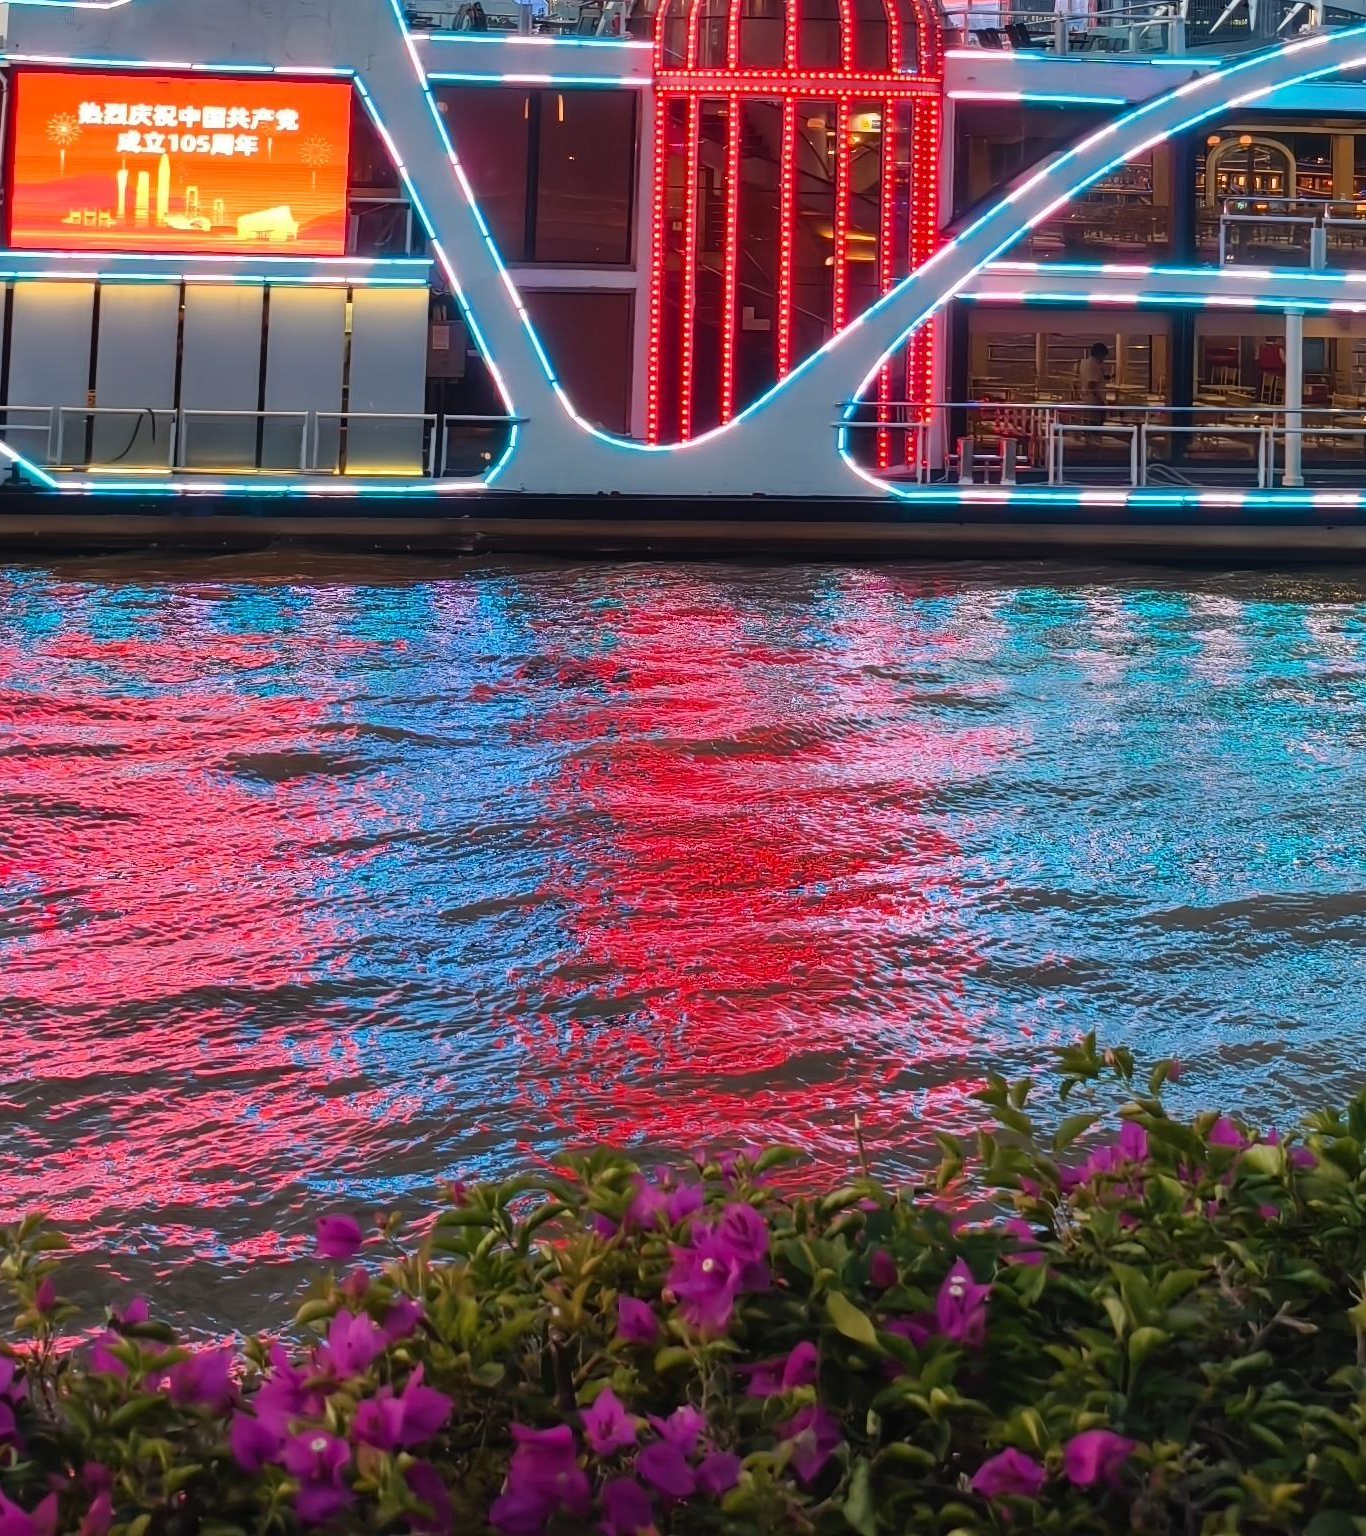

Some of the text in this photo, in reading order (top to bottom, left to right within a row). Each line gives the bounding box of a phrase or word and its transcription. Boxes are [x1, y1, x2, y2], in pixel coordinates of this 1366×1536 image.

[77, 101, 300, 132] 热烈庆祝中国共产党
[116, 131, 260, 157] 成立105周年
